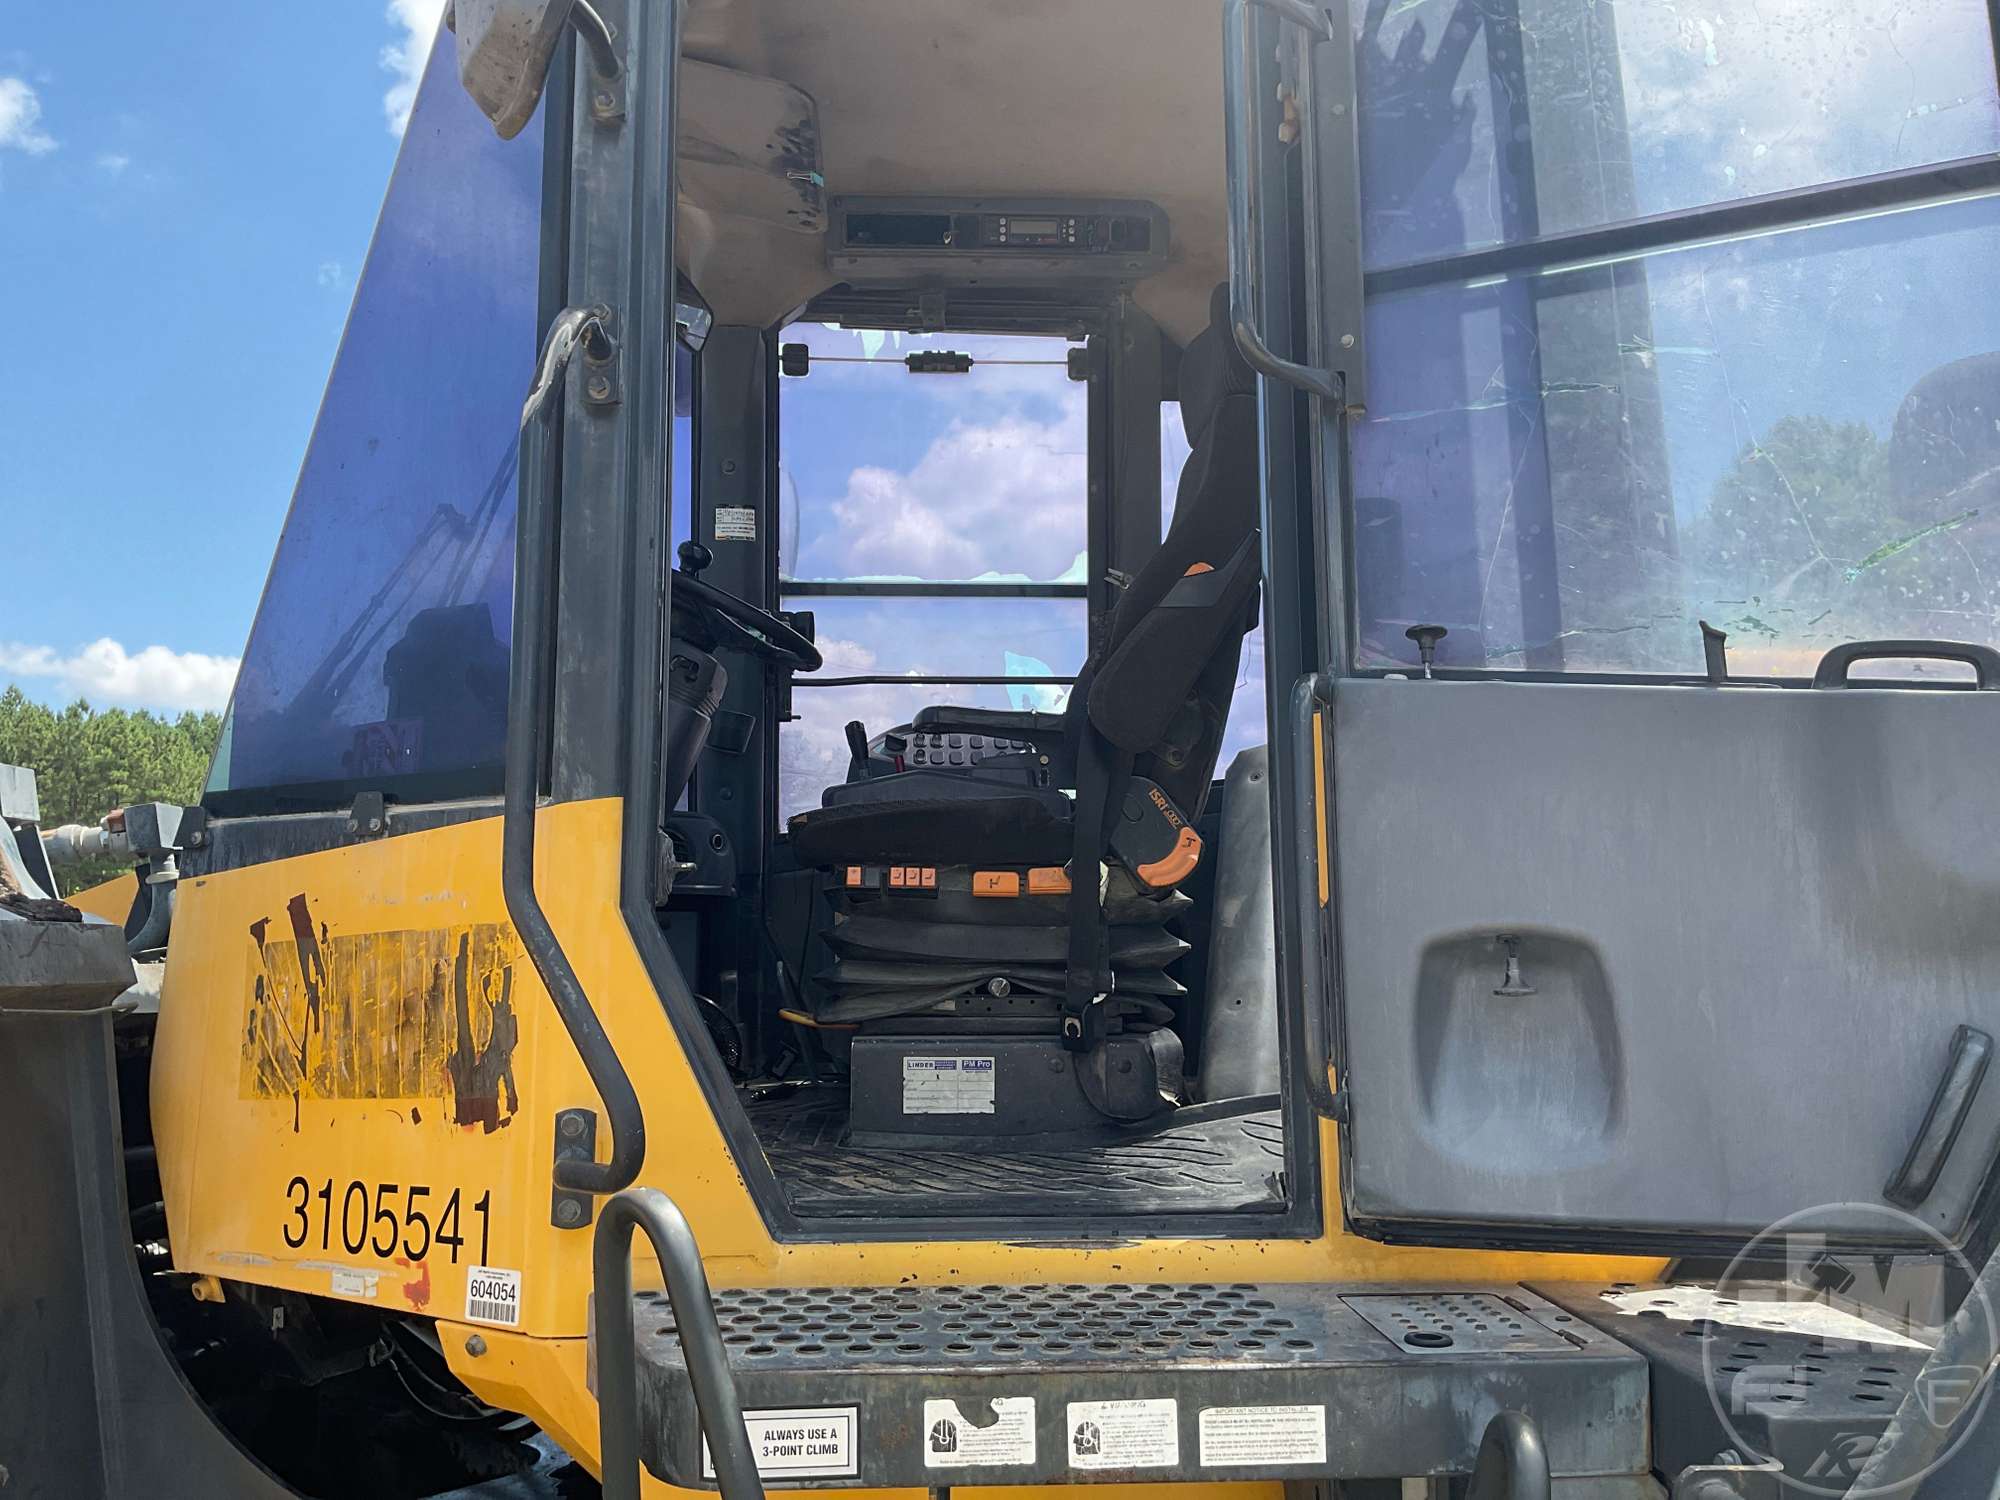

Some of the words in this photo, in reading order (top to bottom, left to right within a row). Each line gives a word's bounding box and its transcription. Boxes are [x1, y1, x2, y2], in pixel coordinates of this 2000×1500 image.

[977, 1060, 991, 1068] Pro
[283, 1176, 491, 1267] 3105541
[471, 1279, 516, 1302] 604054
[764, 1429, 805, 1441] ALWAYS
[808, 1428, 827, 1440] USE
[830, 1428, 837, 1439] A
[762, 1444, 804, 1457] 3-POINT
[806, 1443, 838, 1456] CLIMB
